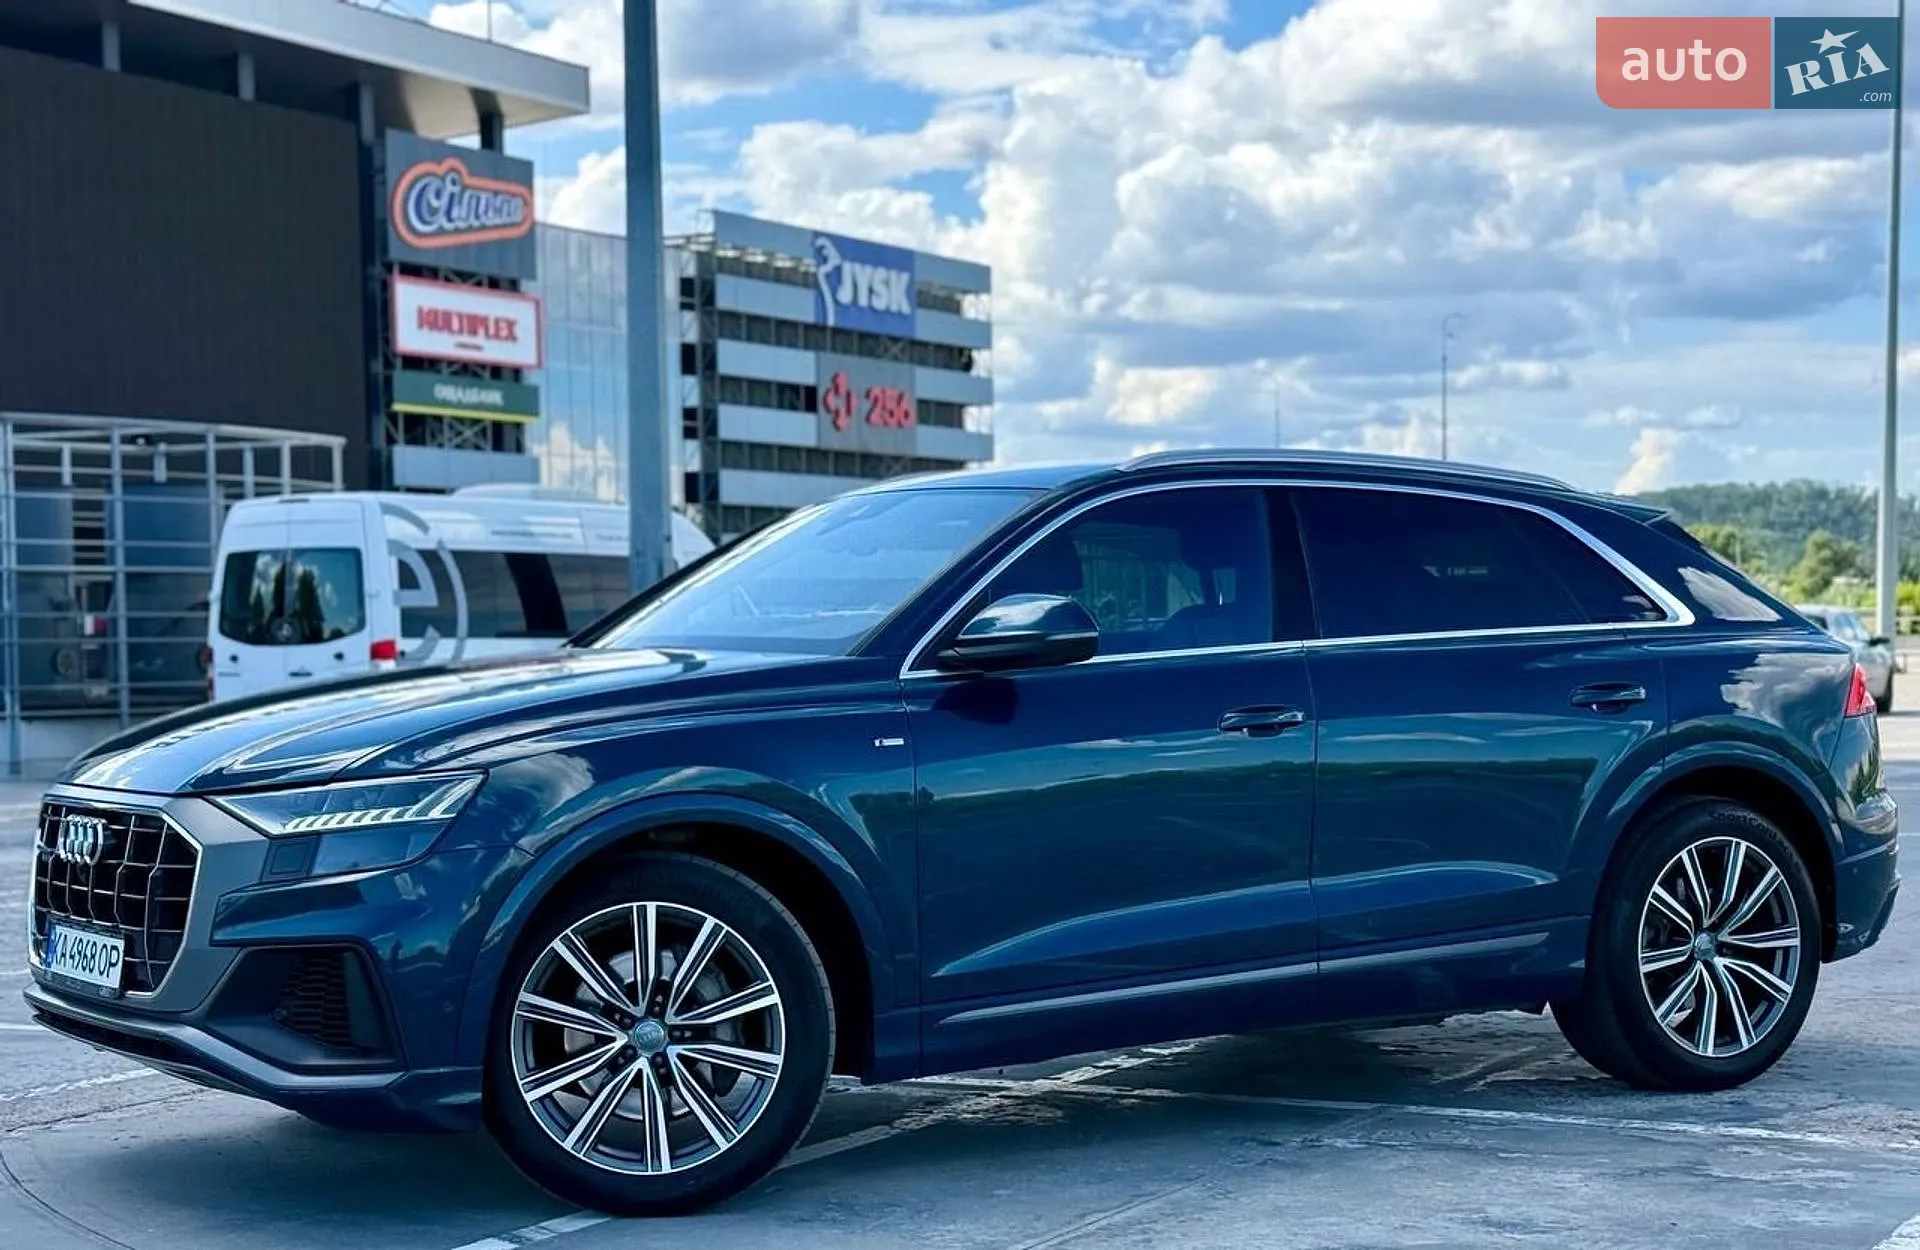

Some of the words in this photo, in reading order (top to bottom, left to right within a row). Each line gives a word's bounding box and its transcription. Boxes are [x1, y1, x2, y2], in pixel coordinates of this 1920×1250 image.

[836, 260, 912, 315] JYSK
[417, 304, 518, 343] MULTIPLEX
[864, 384, 914, 428] 256
